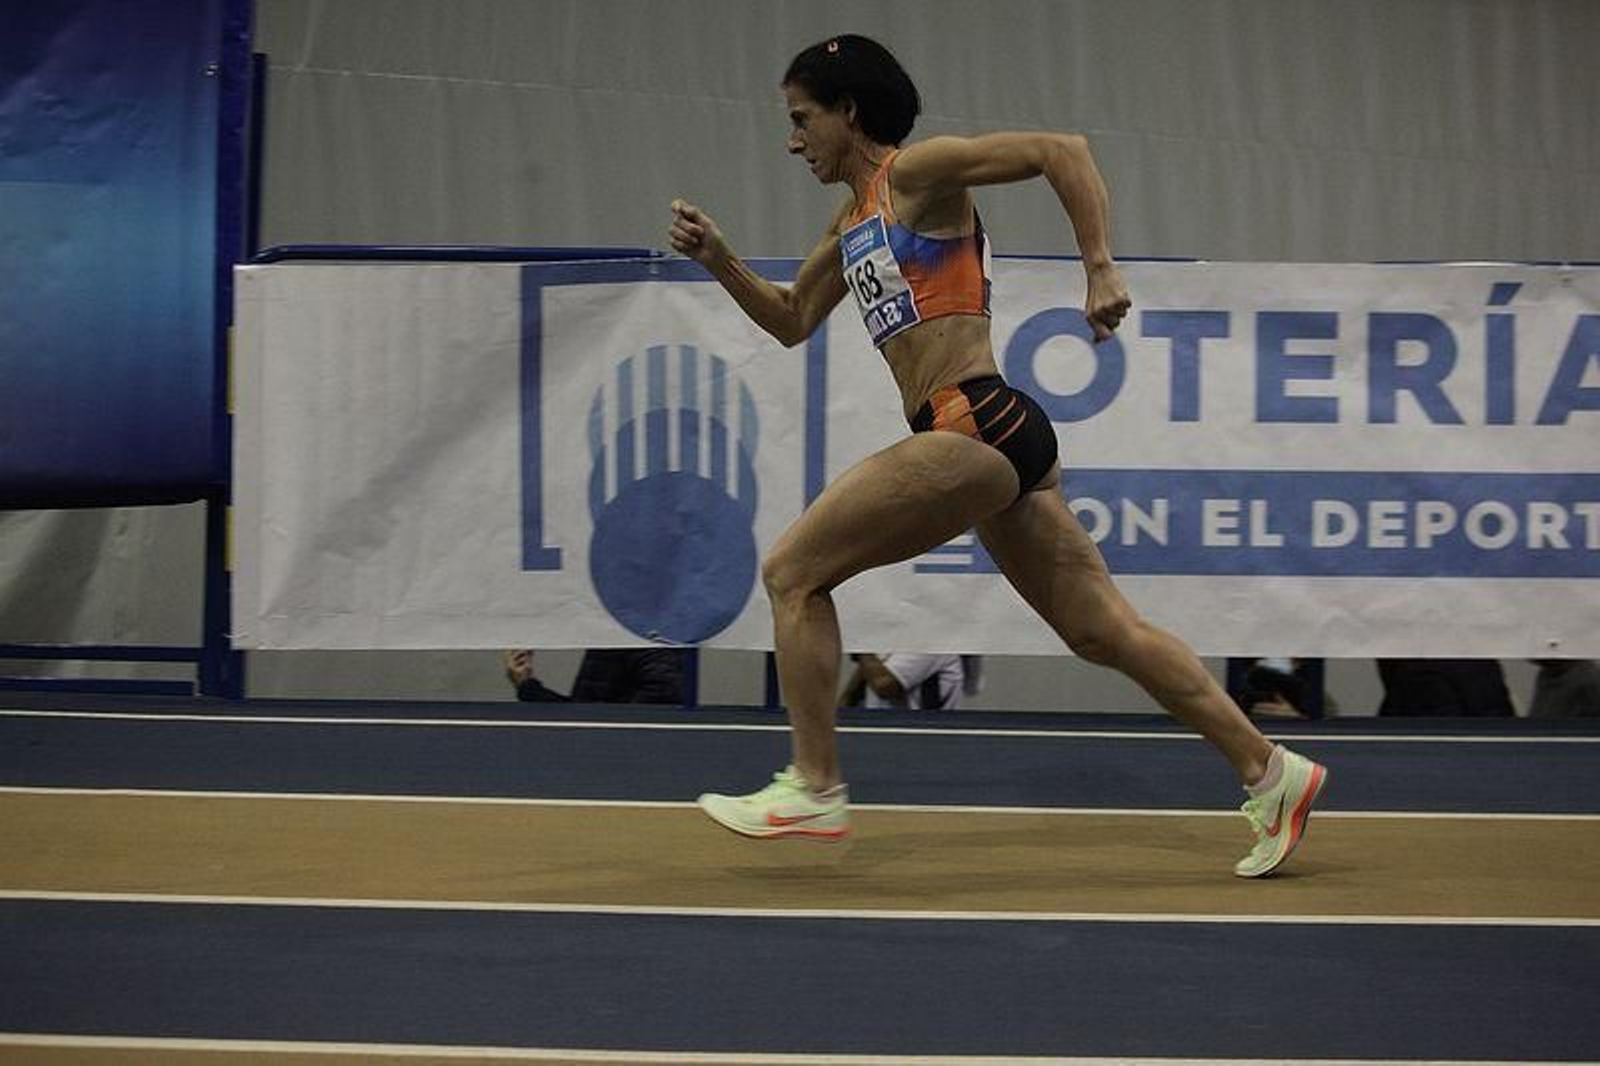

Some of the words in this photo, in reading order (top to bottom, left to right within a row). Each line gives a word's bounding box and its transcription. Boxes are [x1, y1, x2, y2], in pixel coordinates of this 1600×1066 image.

[1004, 282, 1600, 426] OTERÍA
[1068, 497, 1169, 547] ON
[1203, 499, 1284, 548] EL
